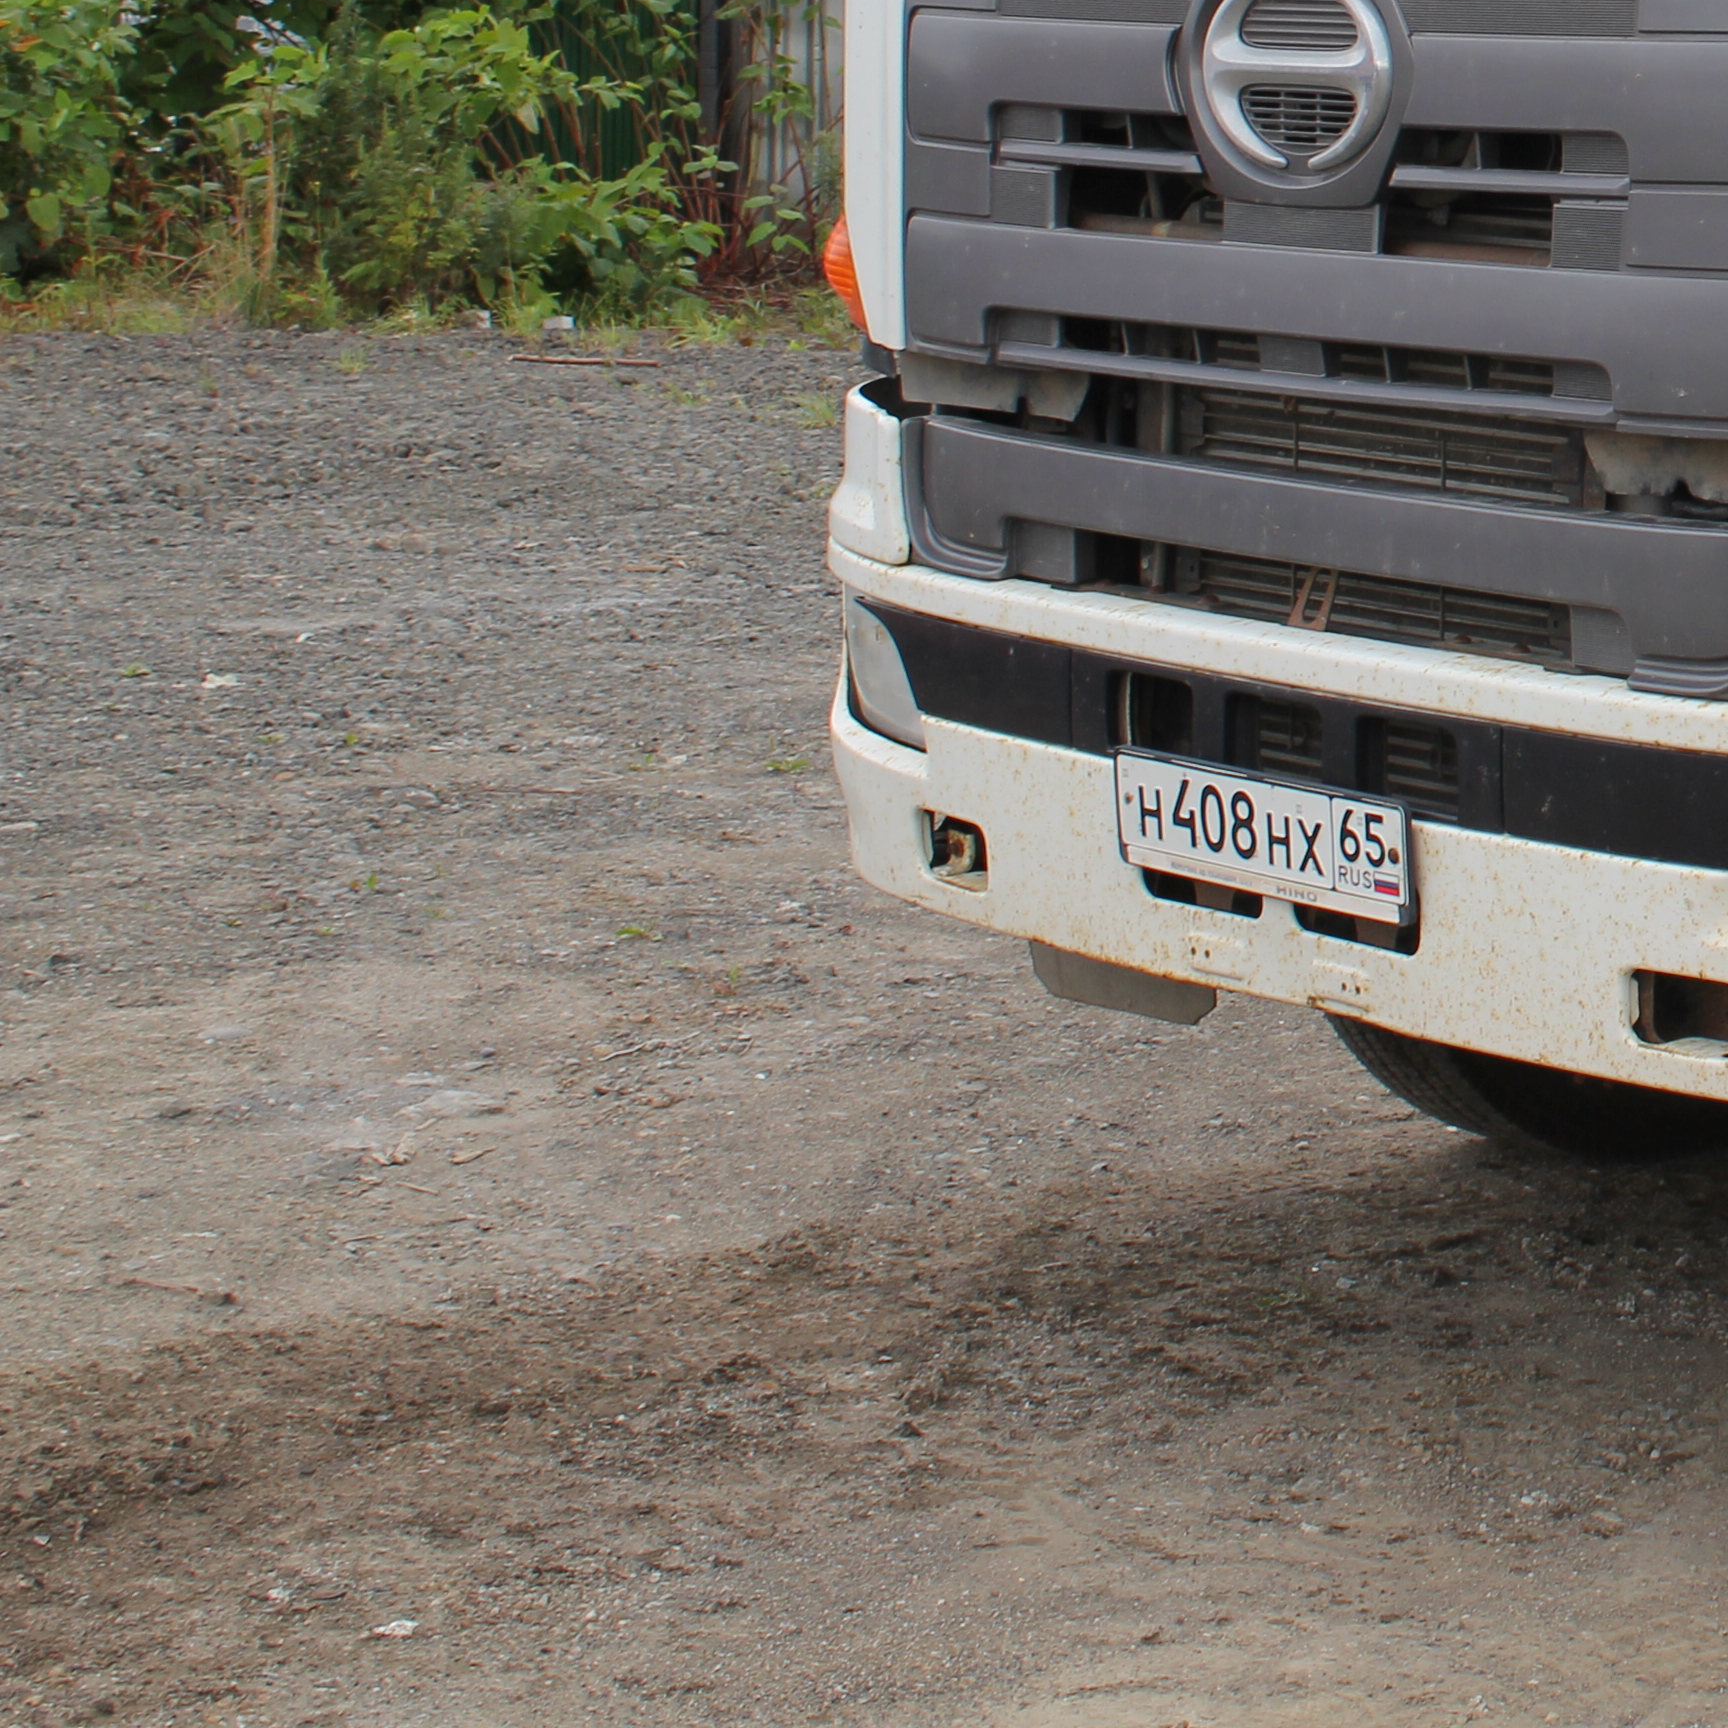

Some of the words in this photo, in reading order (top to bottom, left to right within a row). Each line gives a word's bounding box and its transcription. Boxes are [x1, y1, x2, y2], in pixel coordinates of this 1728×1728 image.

[1340, 808, 1386, 868] 65
[1338, 864, 1372, 890] RUS
[1275, 884, 1319, 904] HINO
